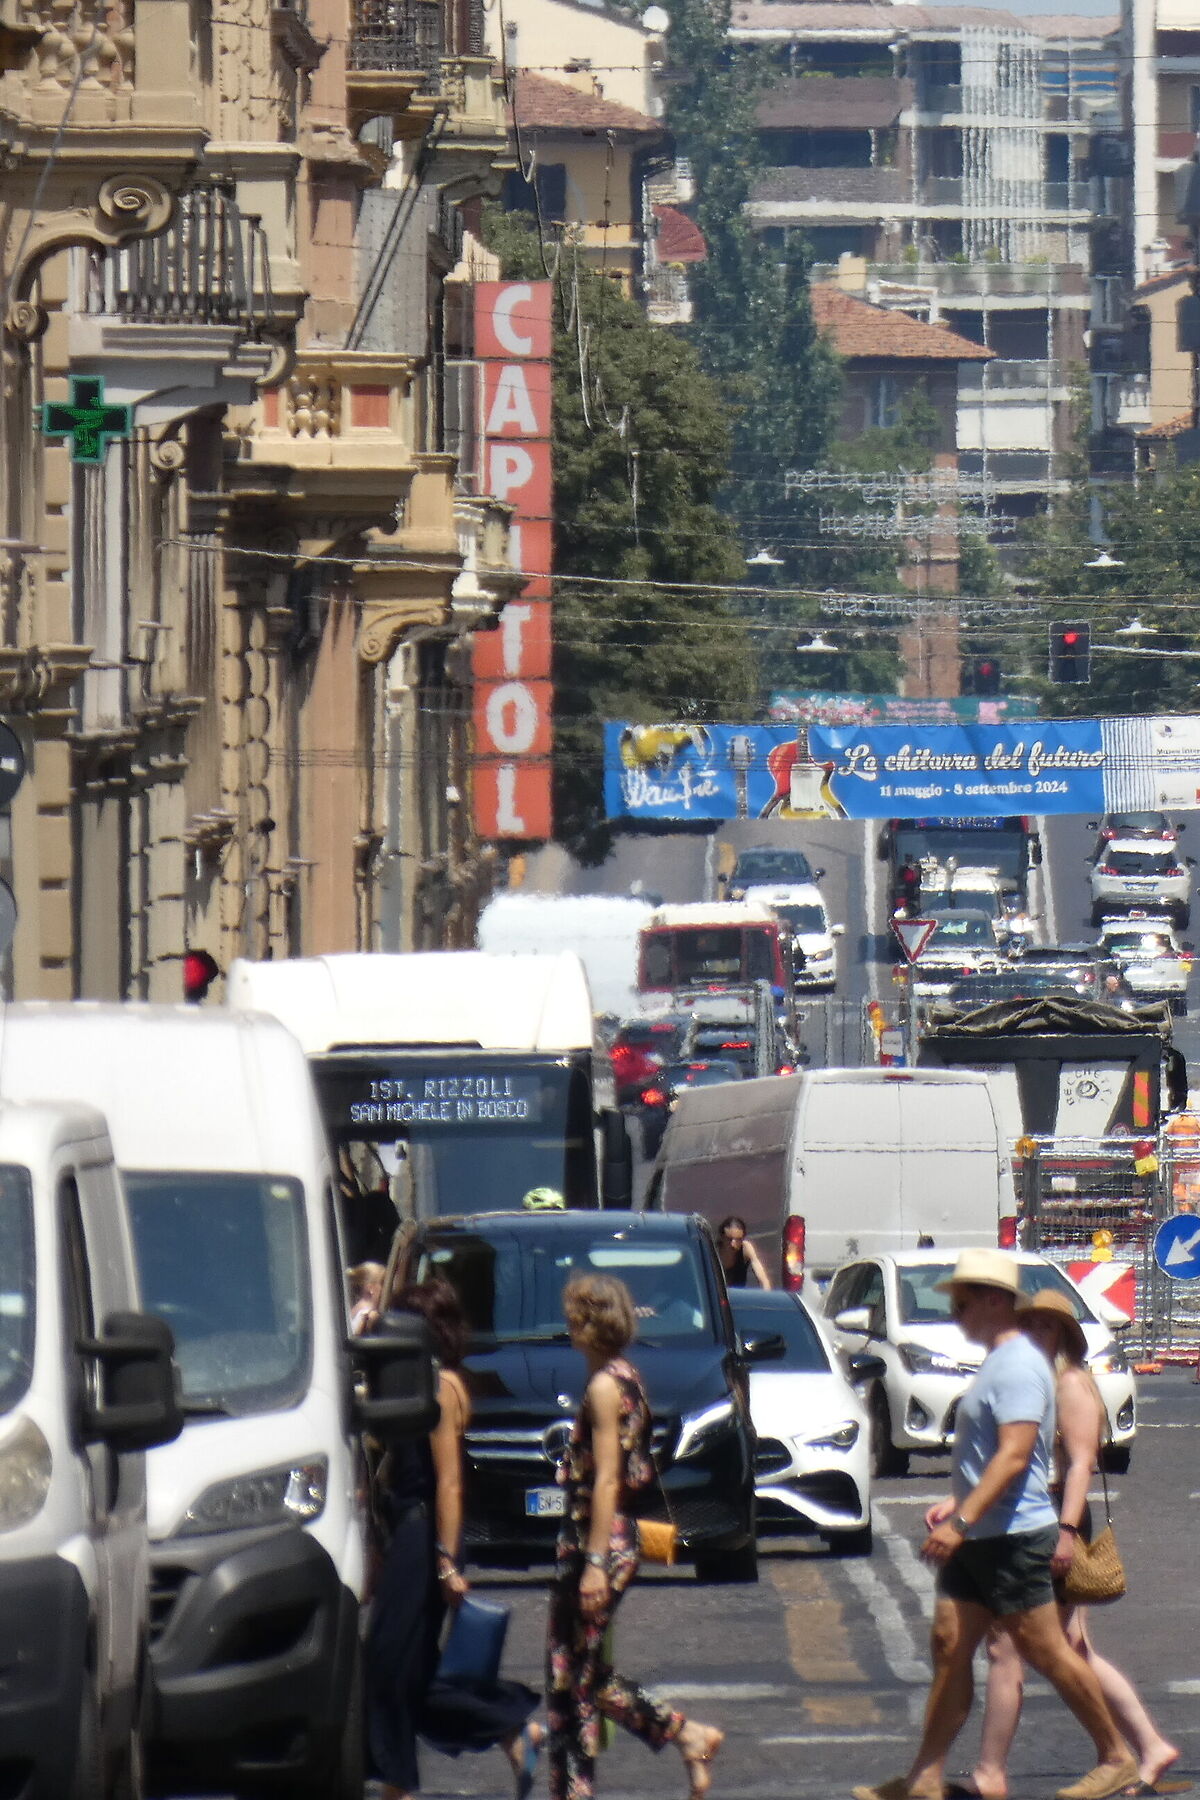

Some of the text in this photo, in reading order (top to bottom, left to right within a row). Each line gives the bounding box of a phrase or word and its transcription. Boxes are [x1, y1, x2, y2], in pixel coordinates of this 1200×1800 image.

[838, 744, 877, 781] La
[984, 742, 1024, 770] del
[1027, 741, 1105, 776] futuro
[880, 785, 891, 797] 11
[894, 783, 943, 799] maggio
[965, 781, 1033, 796] settembre
[1035, 780, 1068, 794] 2024
[370, 1077, 512, 1099] IST. RIZZOLI
[351, 1100, 528, 1121] SAN MICHELE IN BOSCO
